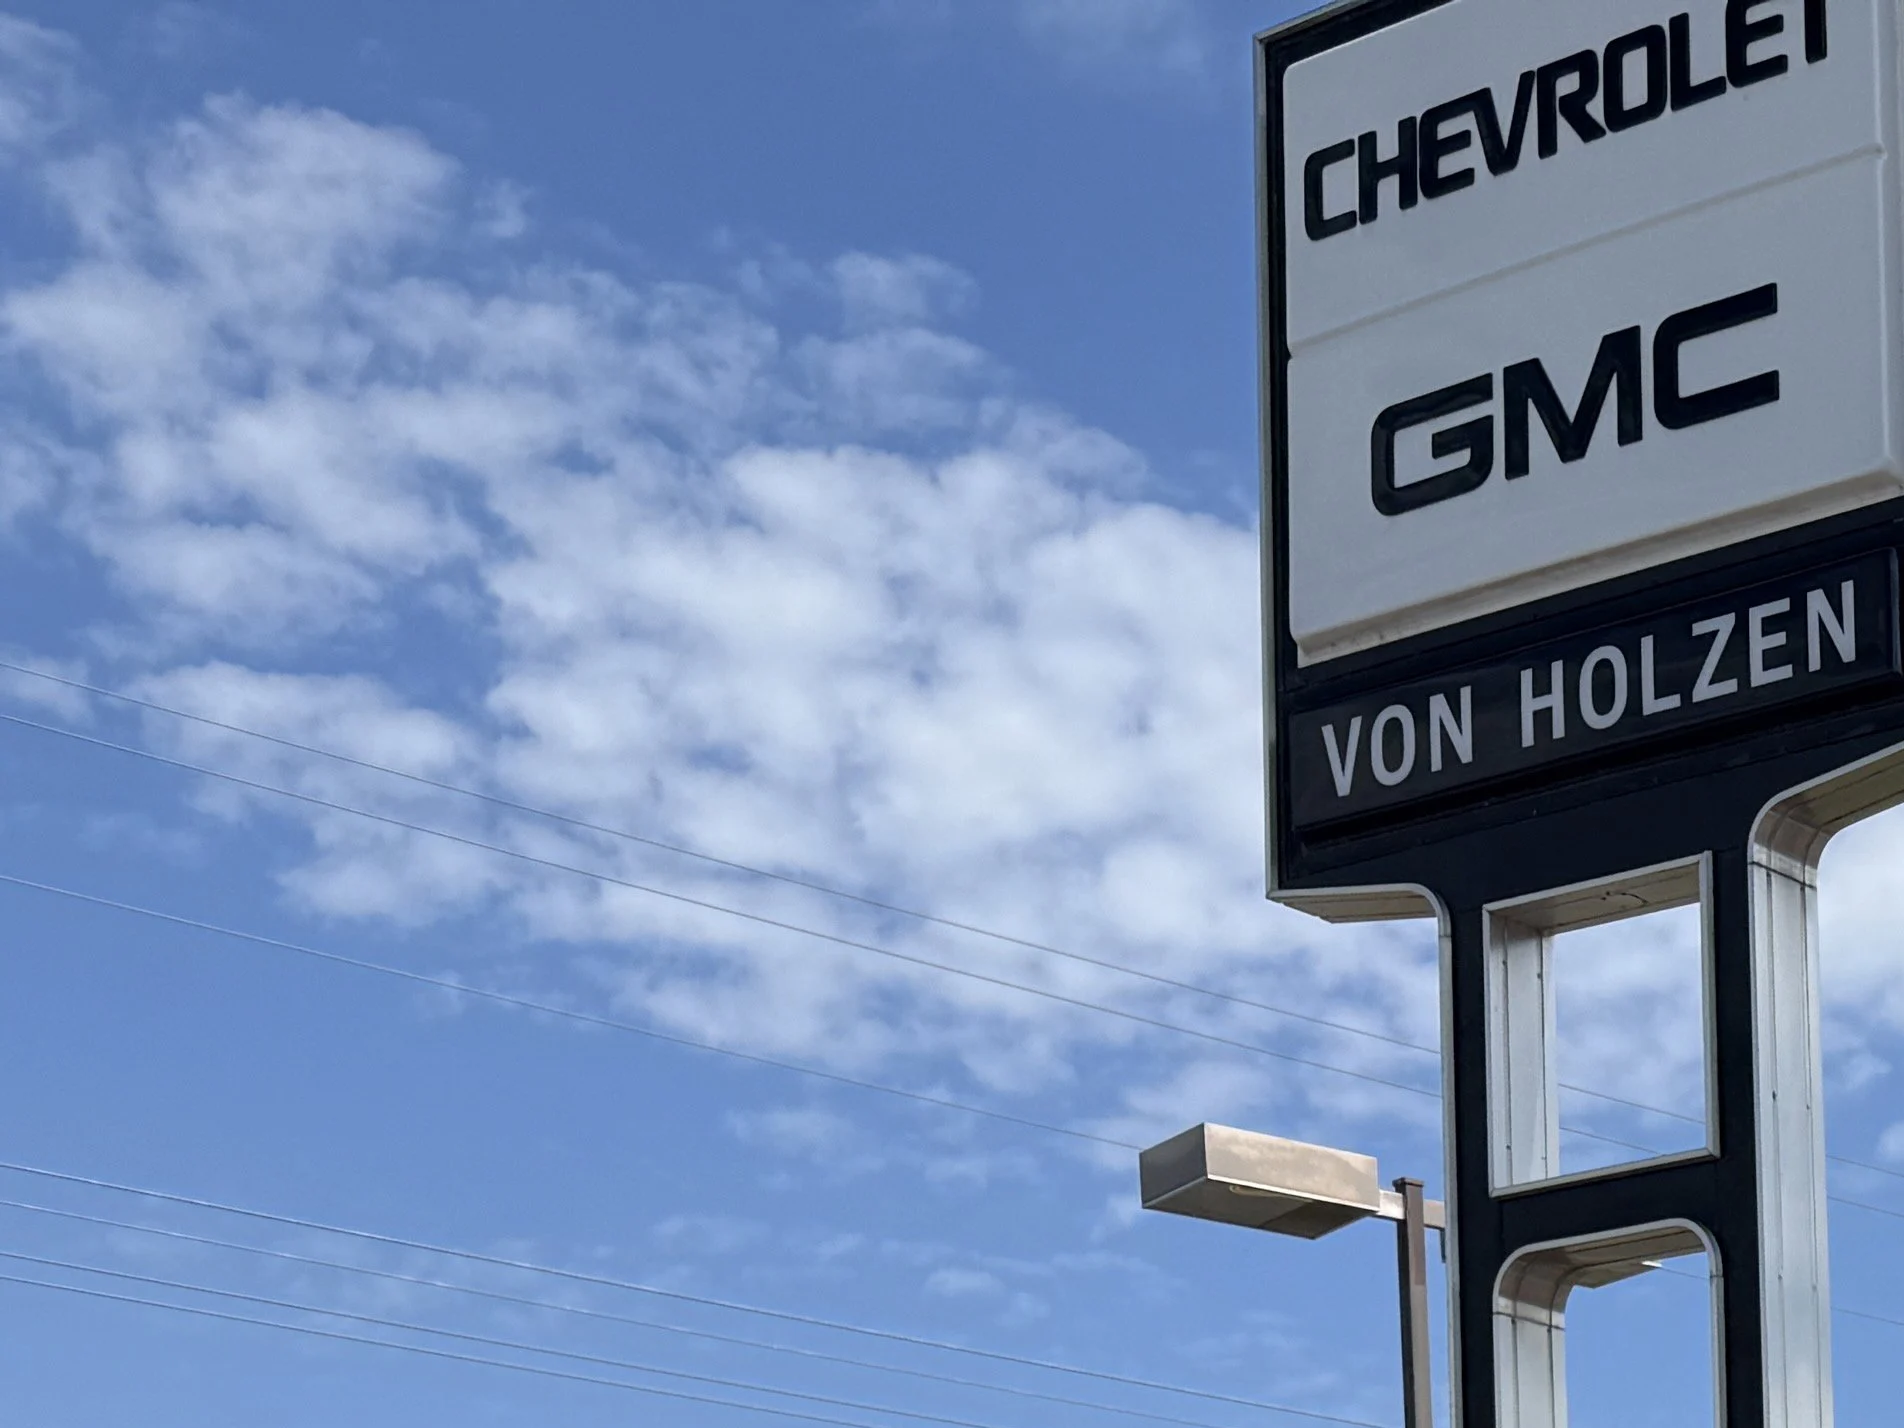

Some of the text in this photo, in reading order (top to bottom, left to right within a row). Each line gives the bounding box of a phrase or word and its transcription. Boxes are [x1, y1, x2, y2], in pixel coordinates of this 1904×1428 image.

[1370, 282, 1780, 517] GMC
[1321, 580, 1858, 798] VON HOLZEN
